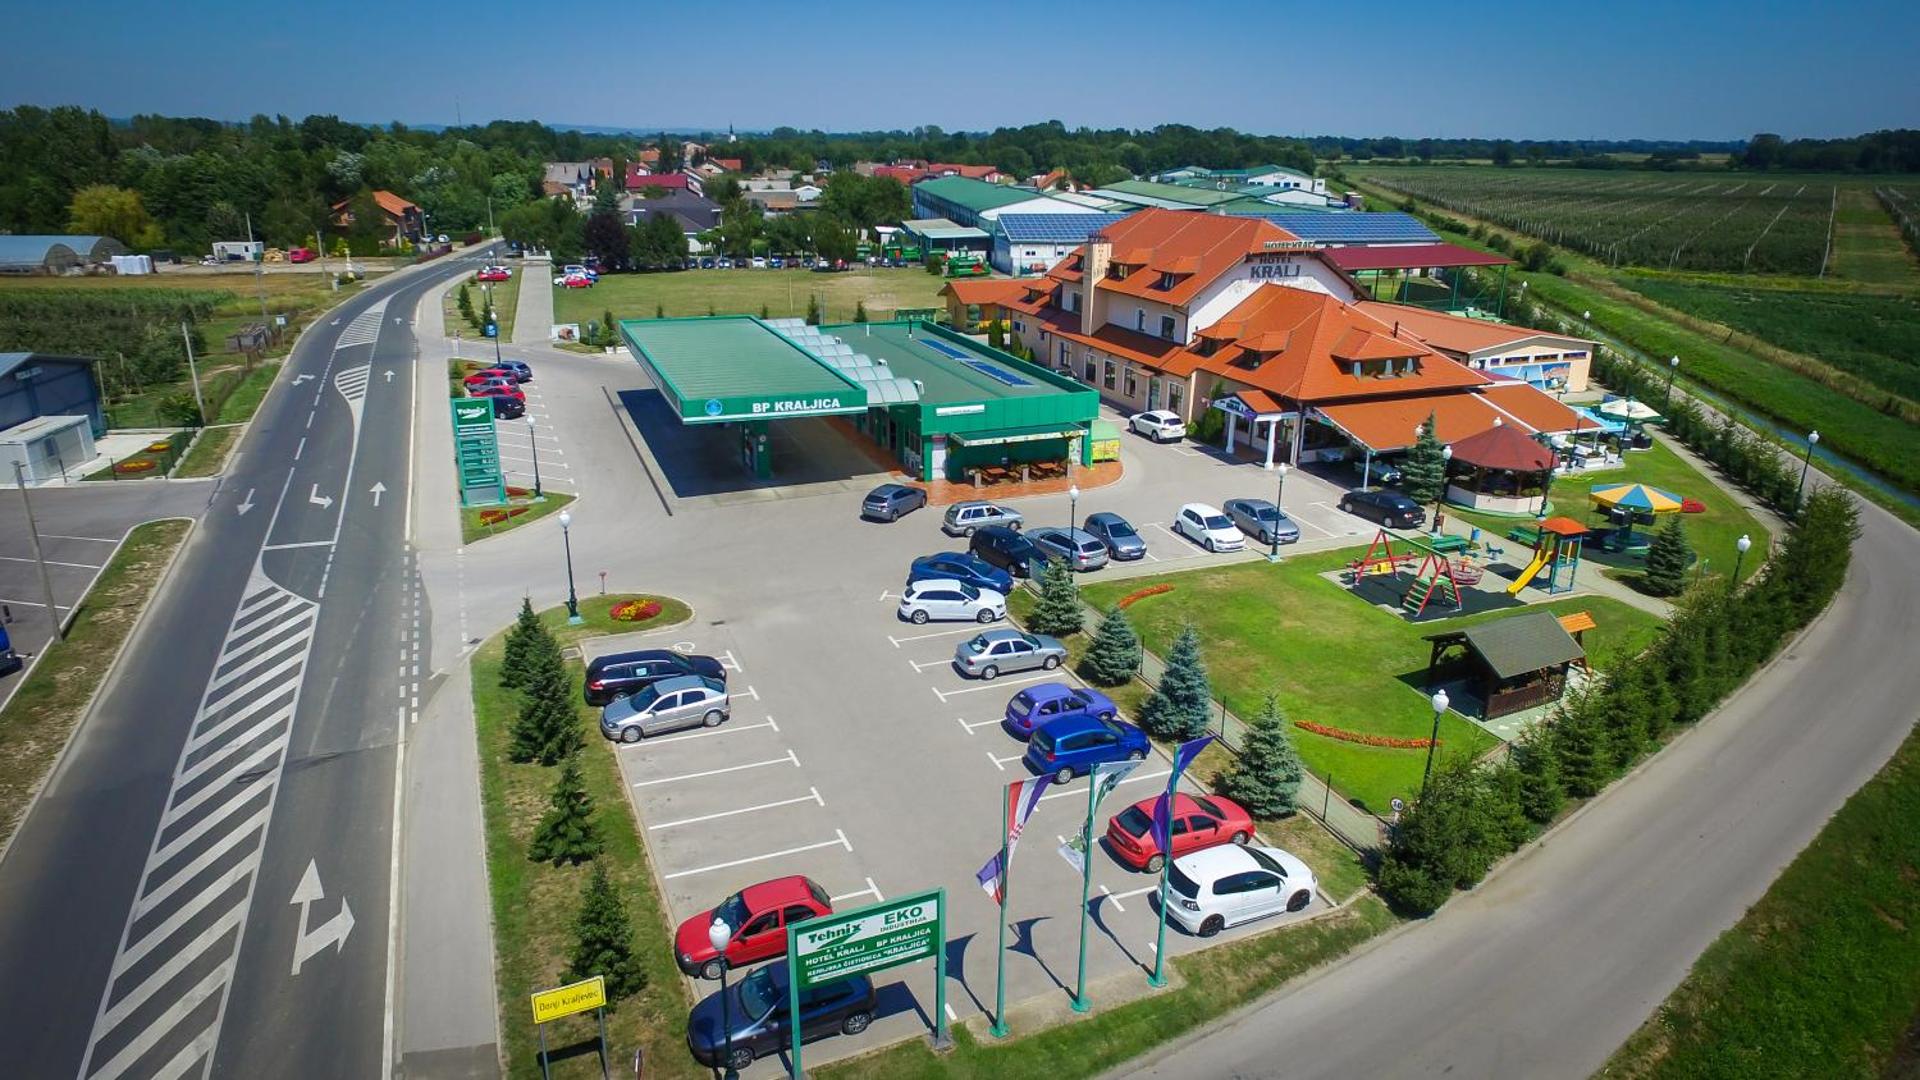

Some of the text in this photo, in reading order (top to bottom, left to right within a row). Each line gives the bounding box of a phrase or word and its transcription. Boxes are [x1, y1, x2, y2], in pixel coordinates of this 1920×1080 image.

[1259, 256, 1293, 264] HOTEL
[1250, 265, 1301, 278] KRALJ
[752, 398, 840, 413] BP KRALJICA
[884, 906, 922, 925] EKO
[808, 923, 862, 943] Tehnix
[806, 928, 931, 966] HOTEL KRALJ BP KRALJICA
